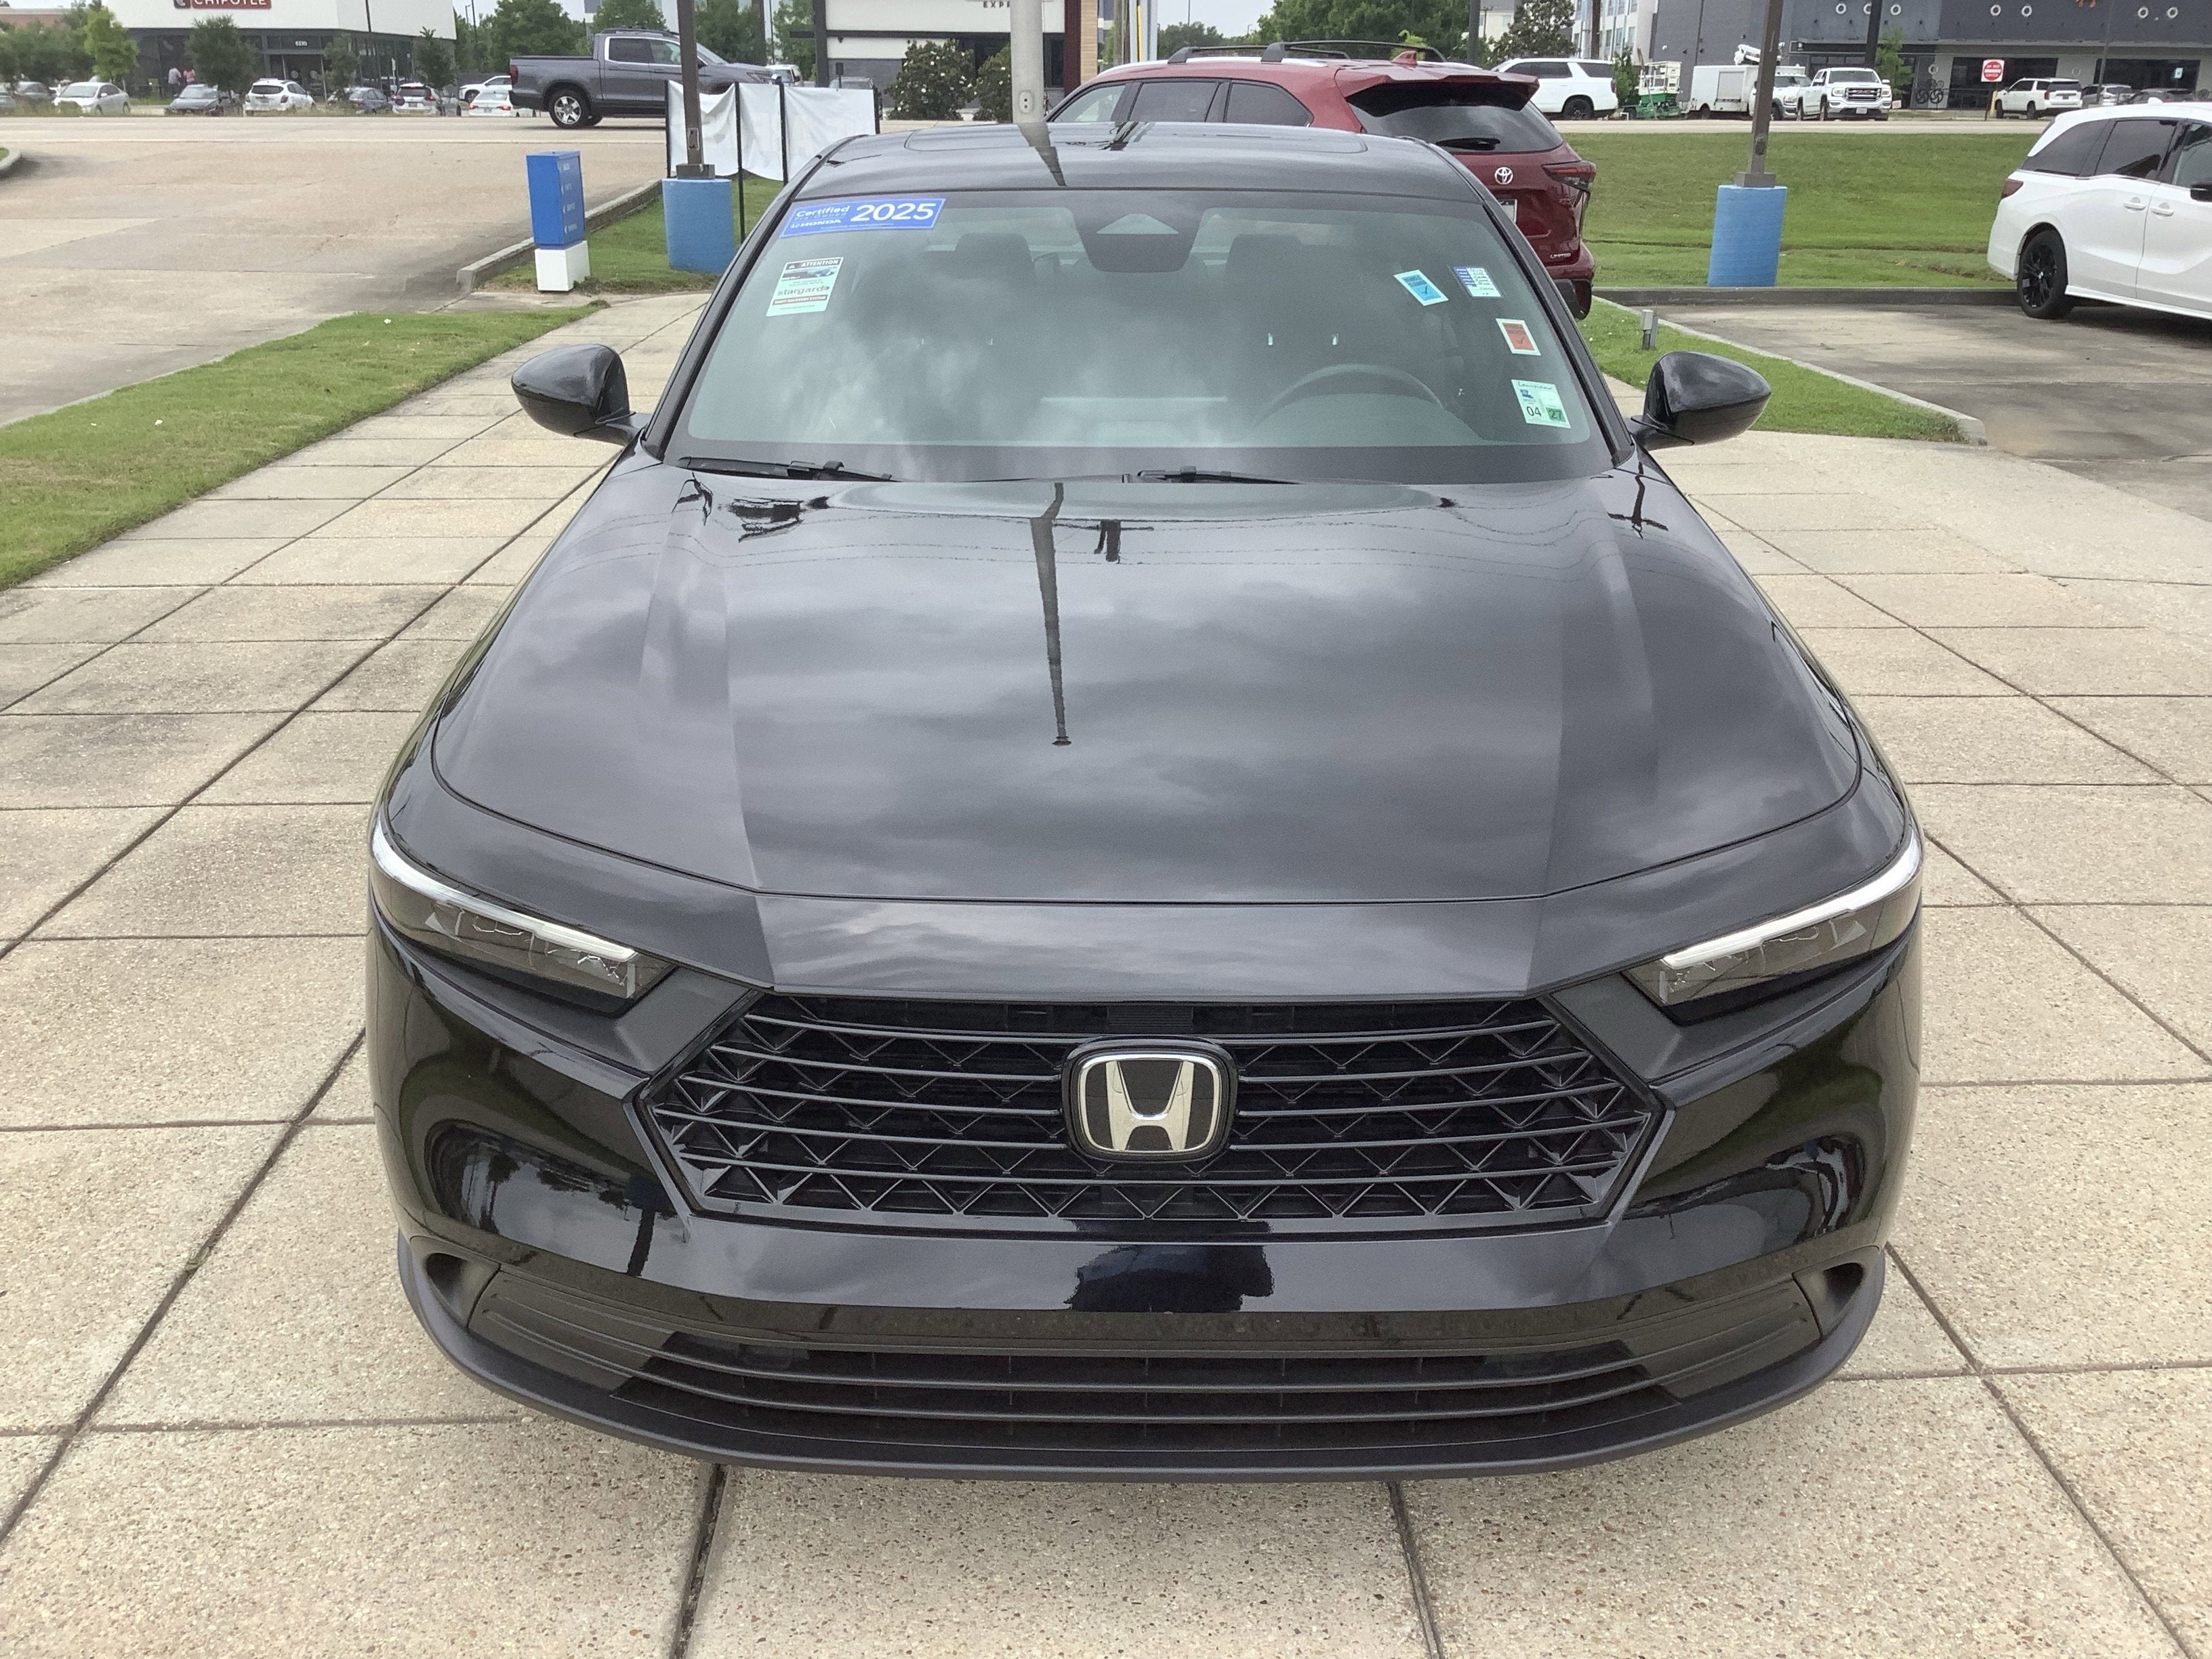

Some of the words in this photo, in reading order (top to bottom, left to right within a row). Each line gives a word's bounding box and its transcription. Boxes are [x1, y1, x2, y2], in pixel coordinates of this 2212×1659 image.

[796, 205, 851, 218] Certified
[850, 203, 937, 223] 2025
[800, 259, 840, 268] ATTENTION
[1526, 406, 1542, 417] 04
[1549, 409, 1563, 420] 27
